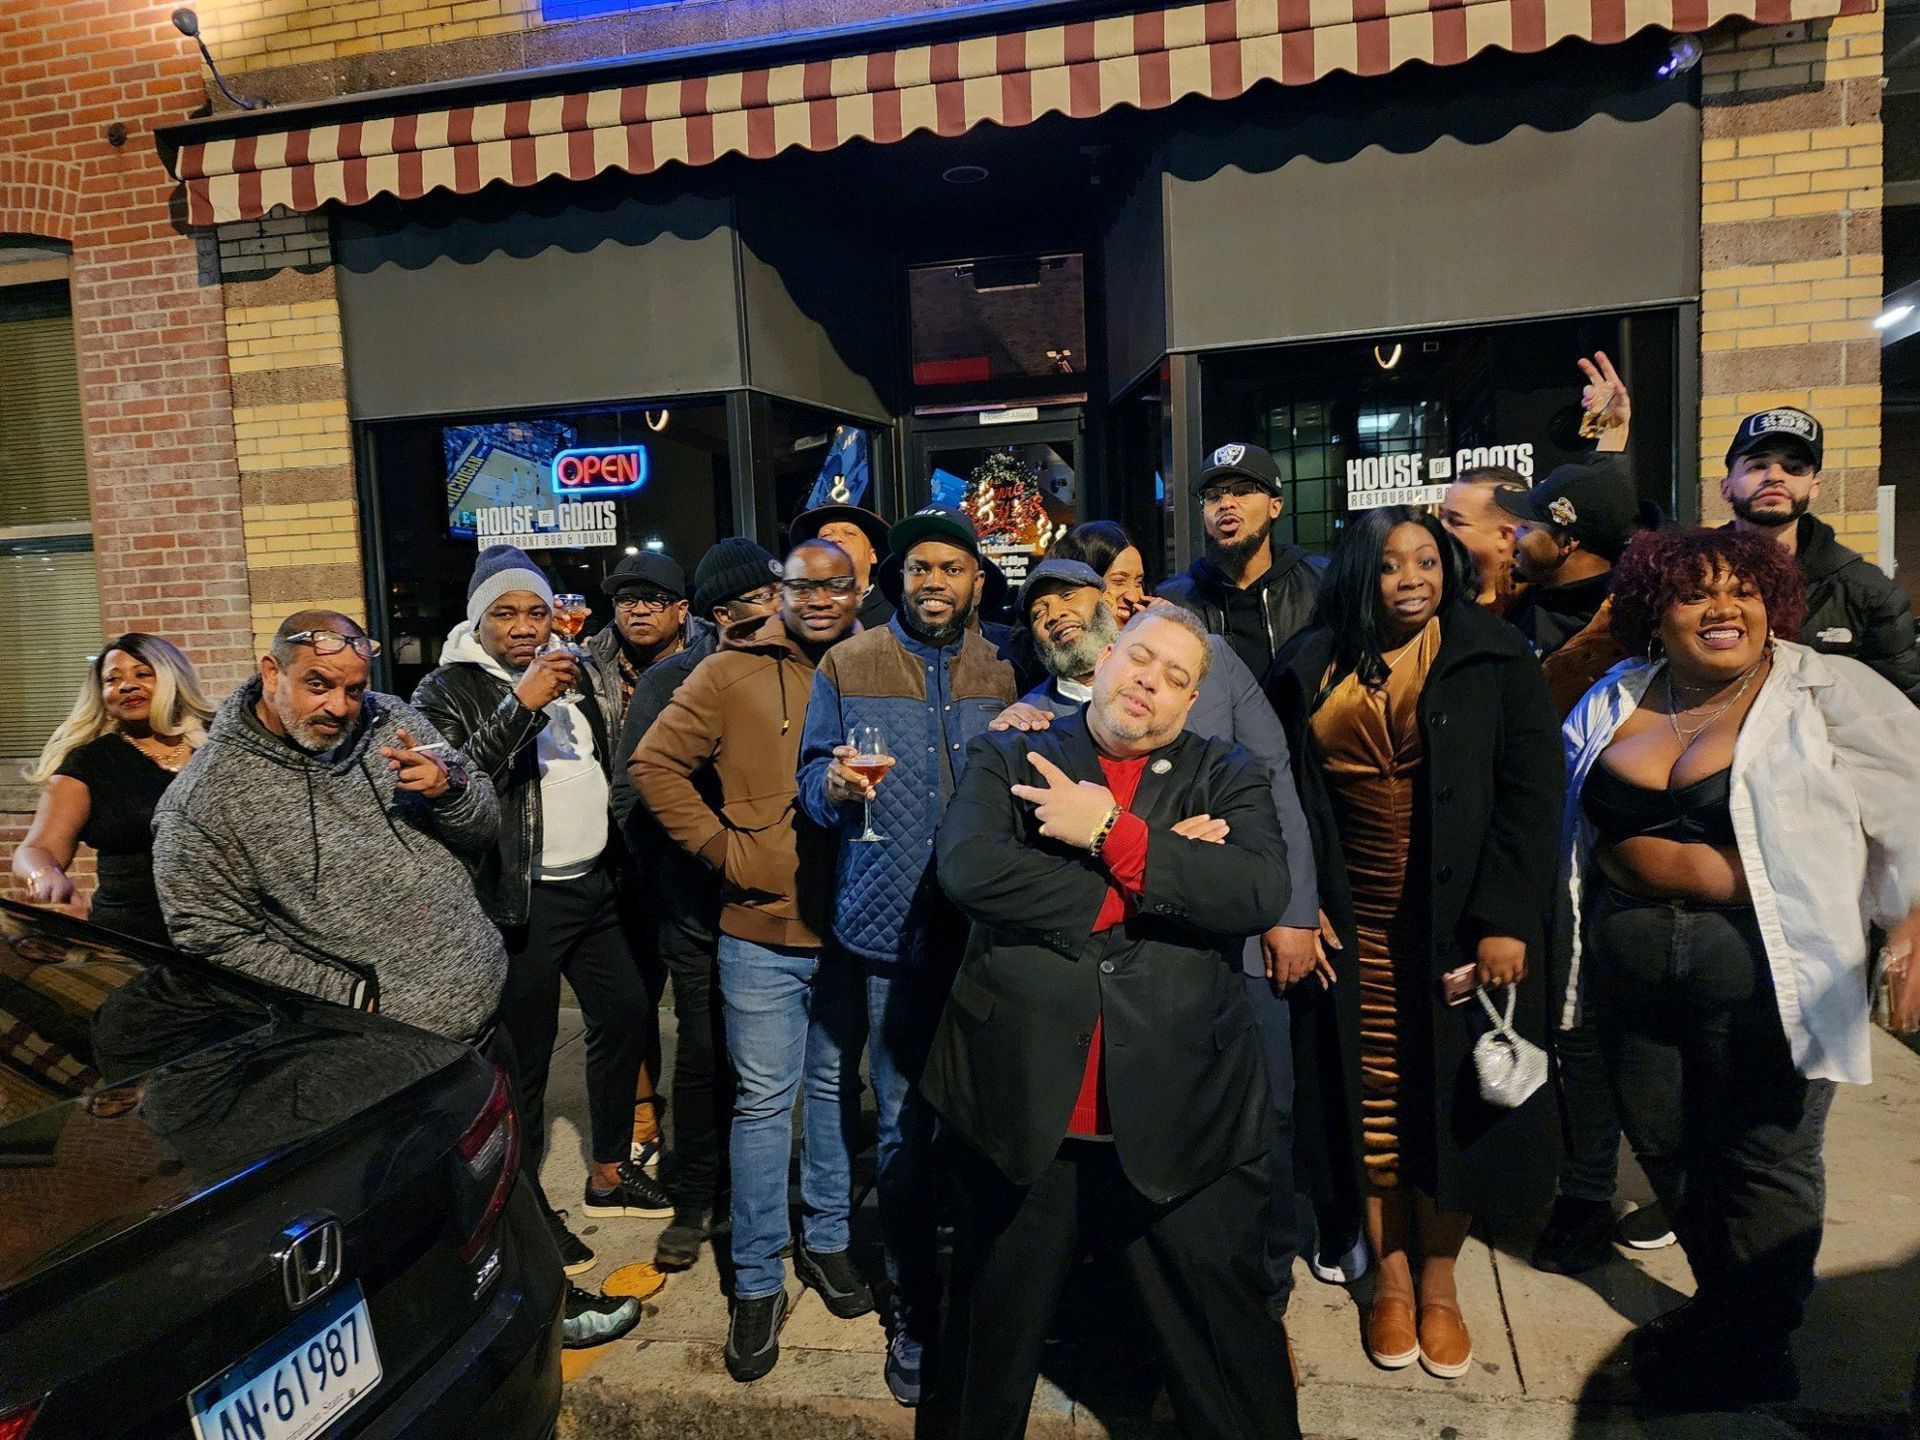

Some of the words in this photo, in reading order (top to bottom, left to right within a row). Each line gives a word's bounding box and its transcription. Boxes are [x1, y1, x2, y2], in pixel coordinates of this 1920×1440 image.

[558, 453, 638, 485] OPEN
[1346, 453, 1423, 491] HOUSE
[1351, 488, 1429, 506] RESTAURANT
[476, 505, 535, 536] HOUSE
[558, 500, 617, 531] GOATS
[544, 534, 564, 546] BAR
[577, 531, 614, 544] LOUNGE
